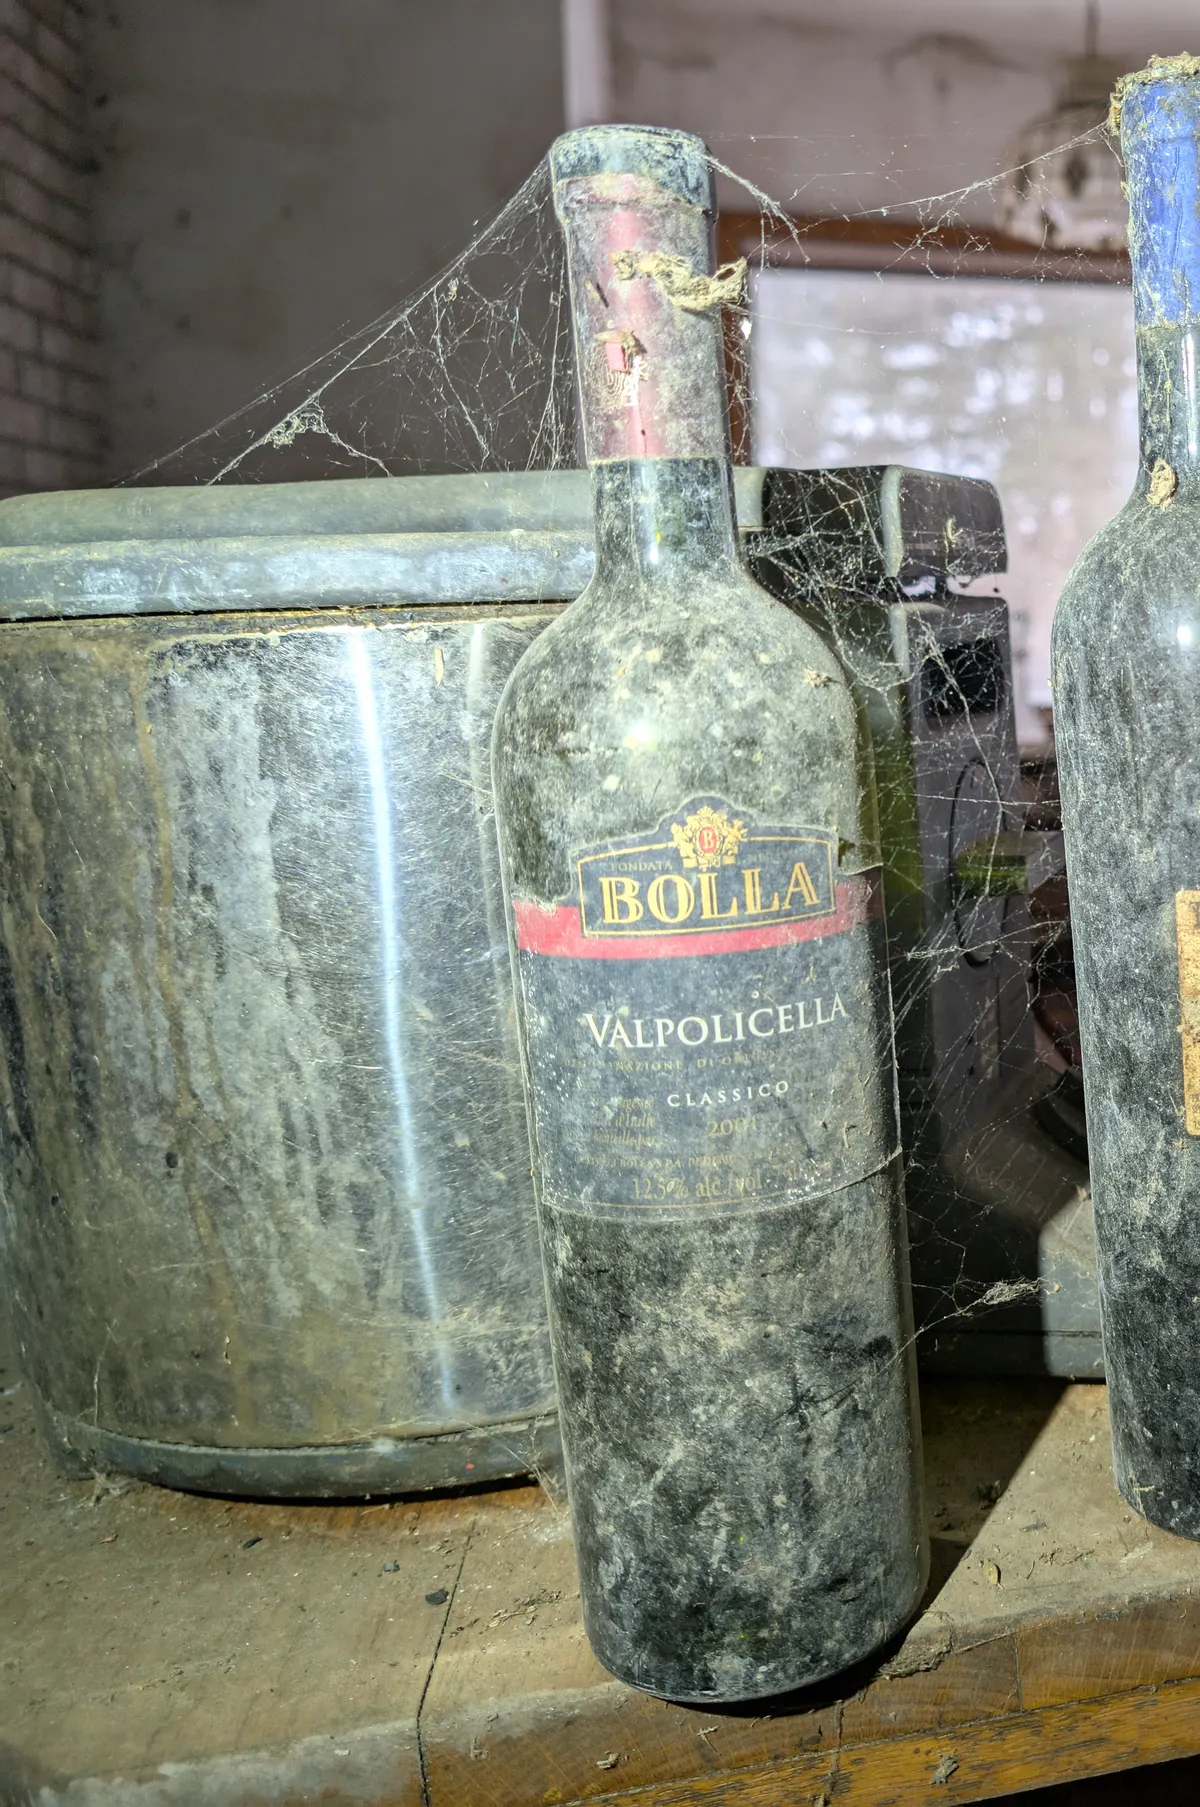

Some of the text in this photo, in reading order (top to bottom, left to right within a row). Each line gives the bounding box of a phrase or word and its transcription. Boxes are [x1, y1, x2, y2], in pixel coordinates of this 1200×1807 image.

[610, 859, 673, 872] FONDATA
[598, 861, 820, 924] BOLLA
[582, 991, 849, 1049] VALPOLICELLA
[667, 1081, 789, 1107] CLASSICO
